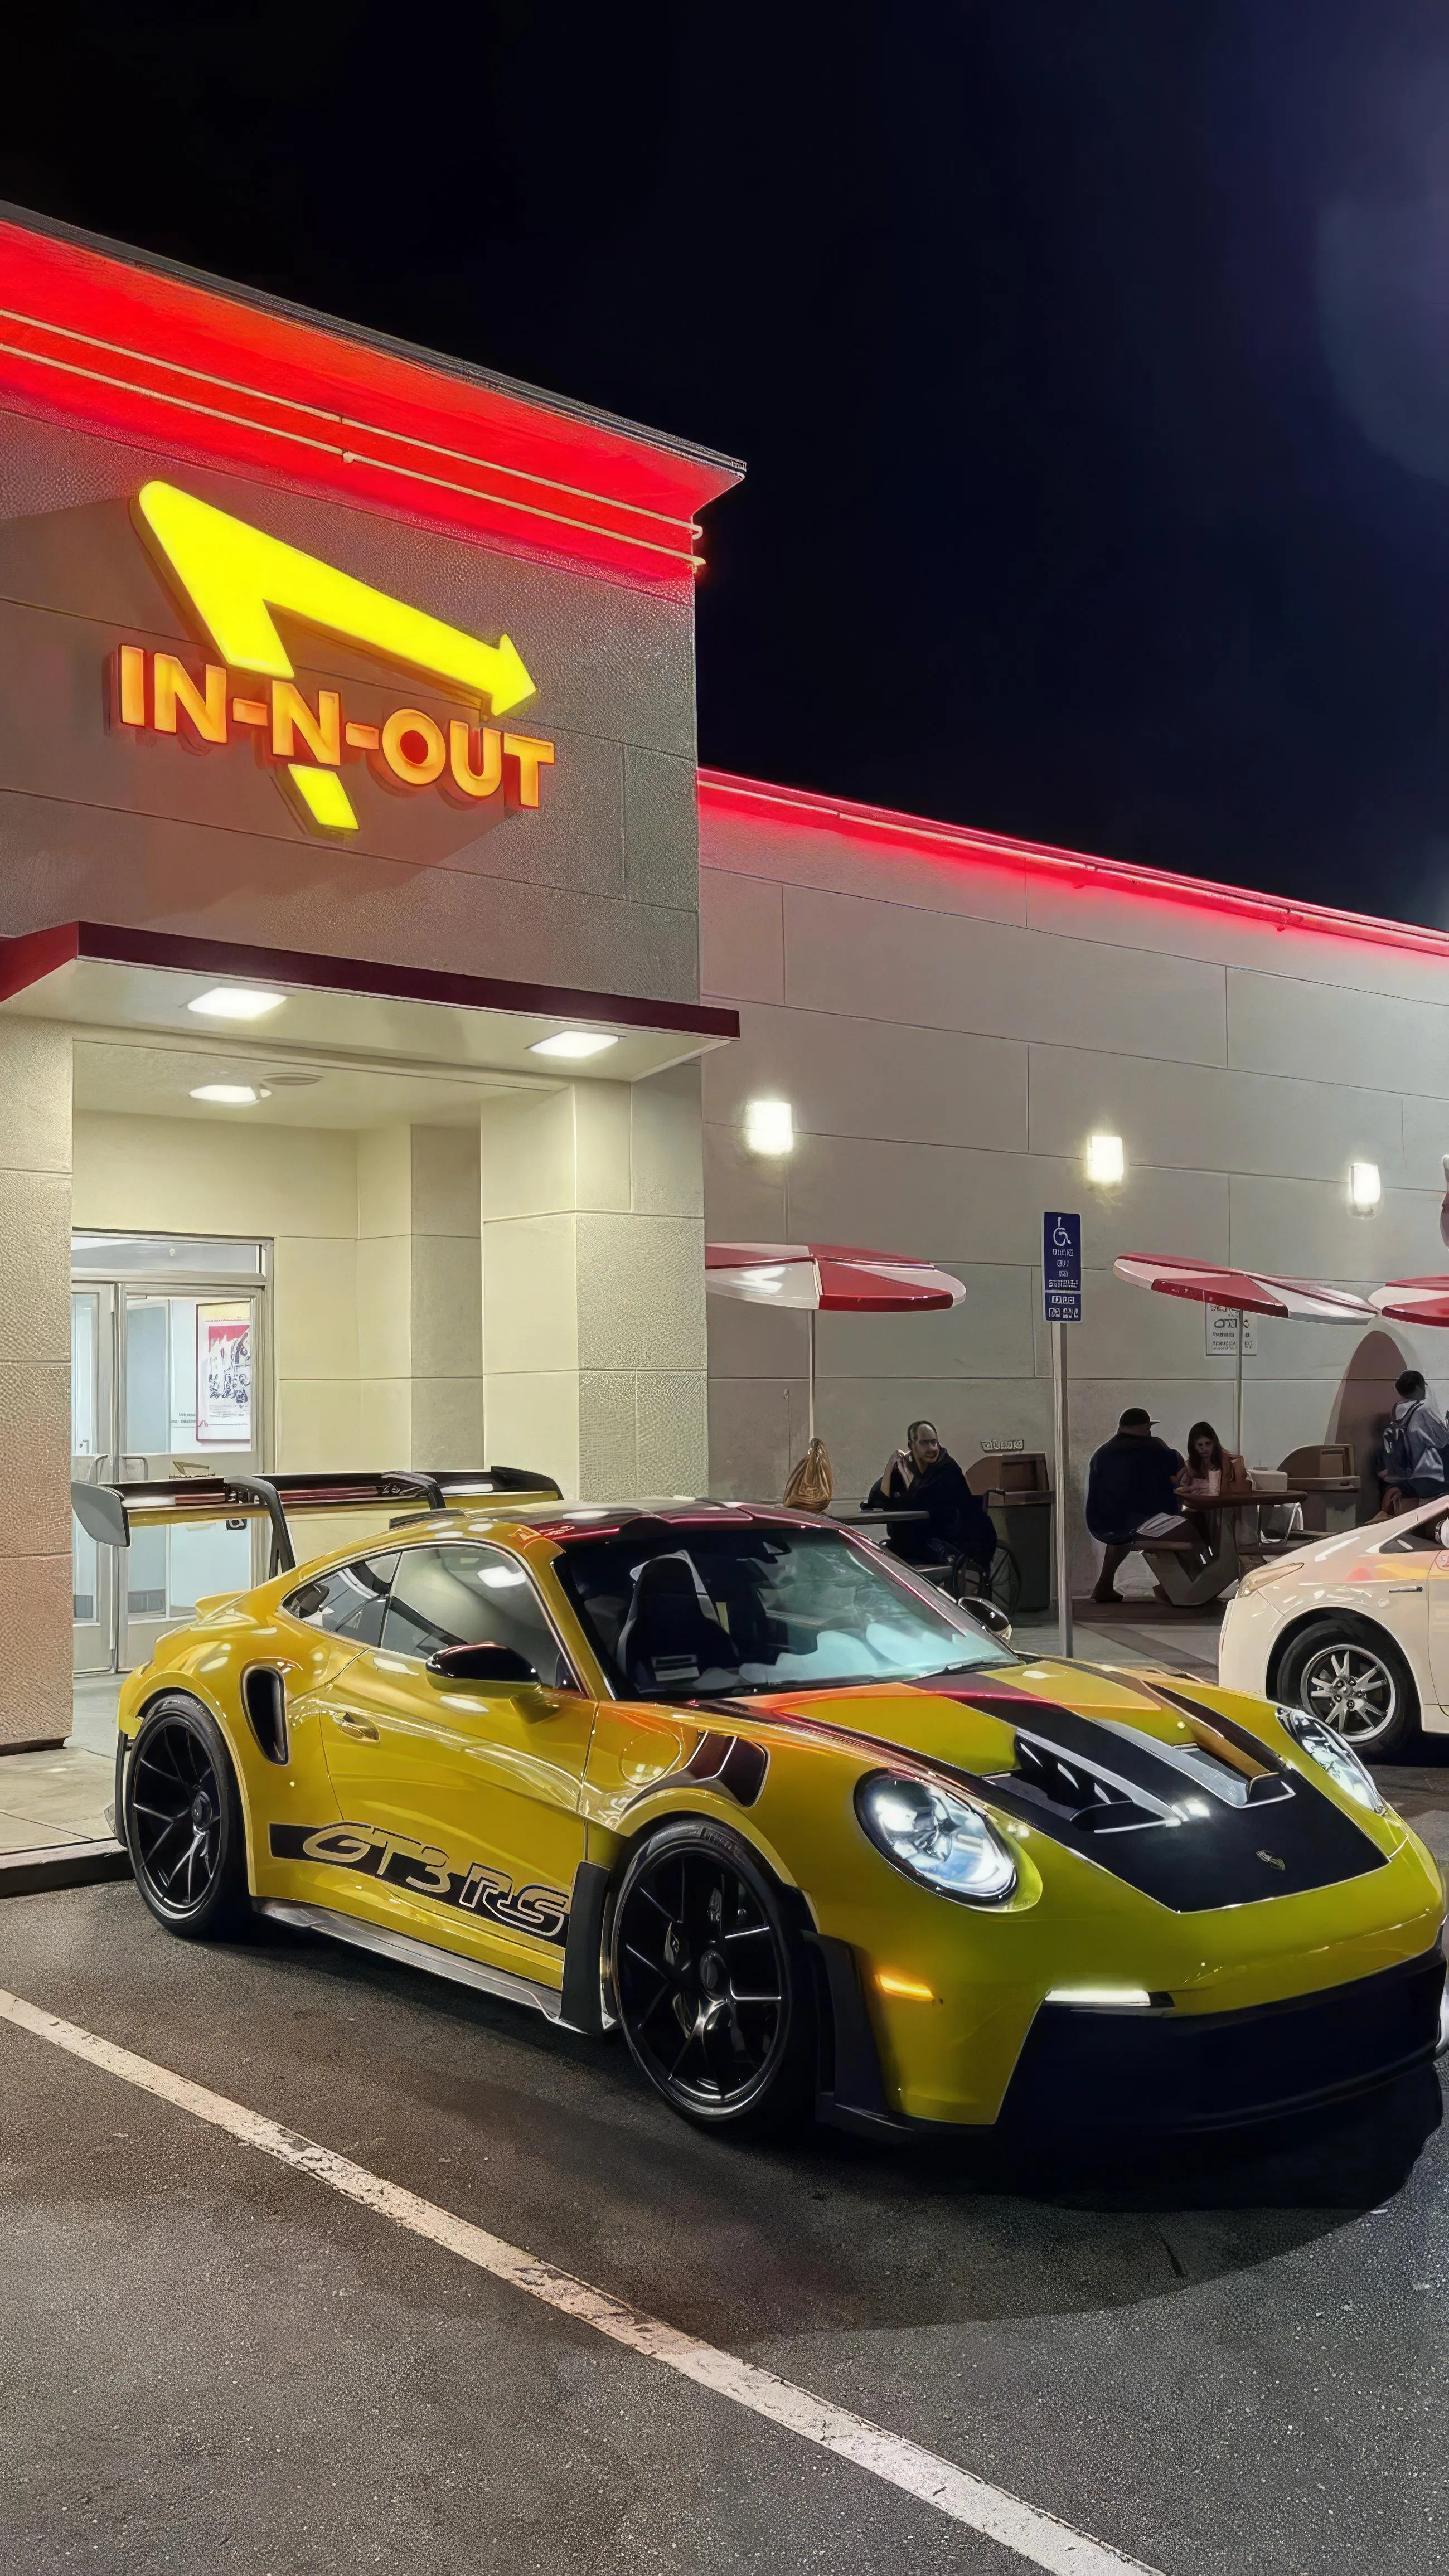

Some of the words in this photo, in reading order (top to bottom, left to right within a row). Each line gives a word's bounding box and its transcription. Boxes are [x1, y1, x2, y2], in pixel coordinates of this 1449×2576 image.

[119, 644, 555, 809] IN-N-OUT
[303, 1823, 452, 1894] GT3
[459, 1862, 570, 1937] RS
